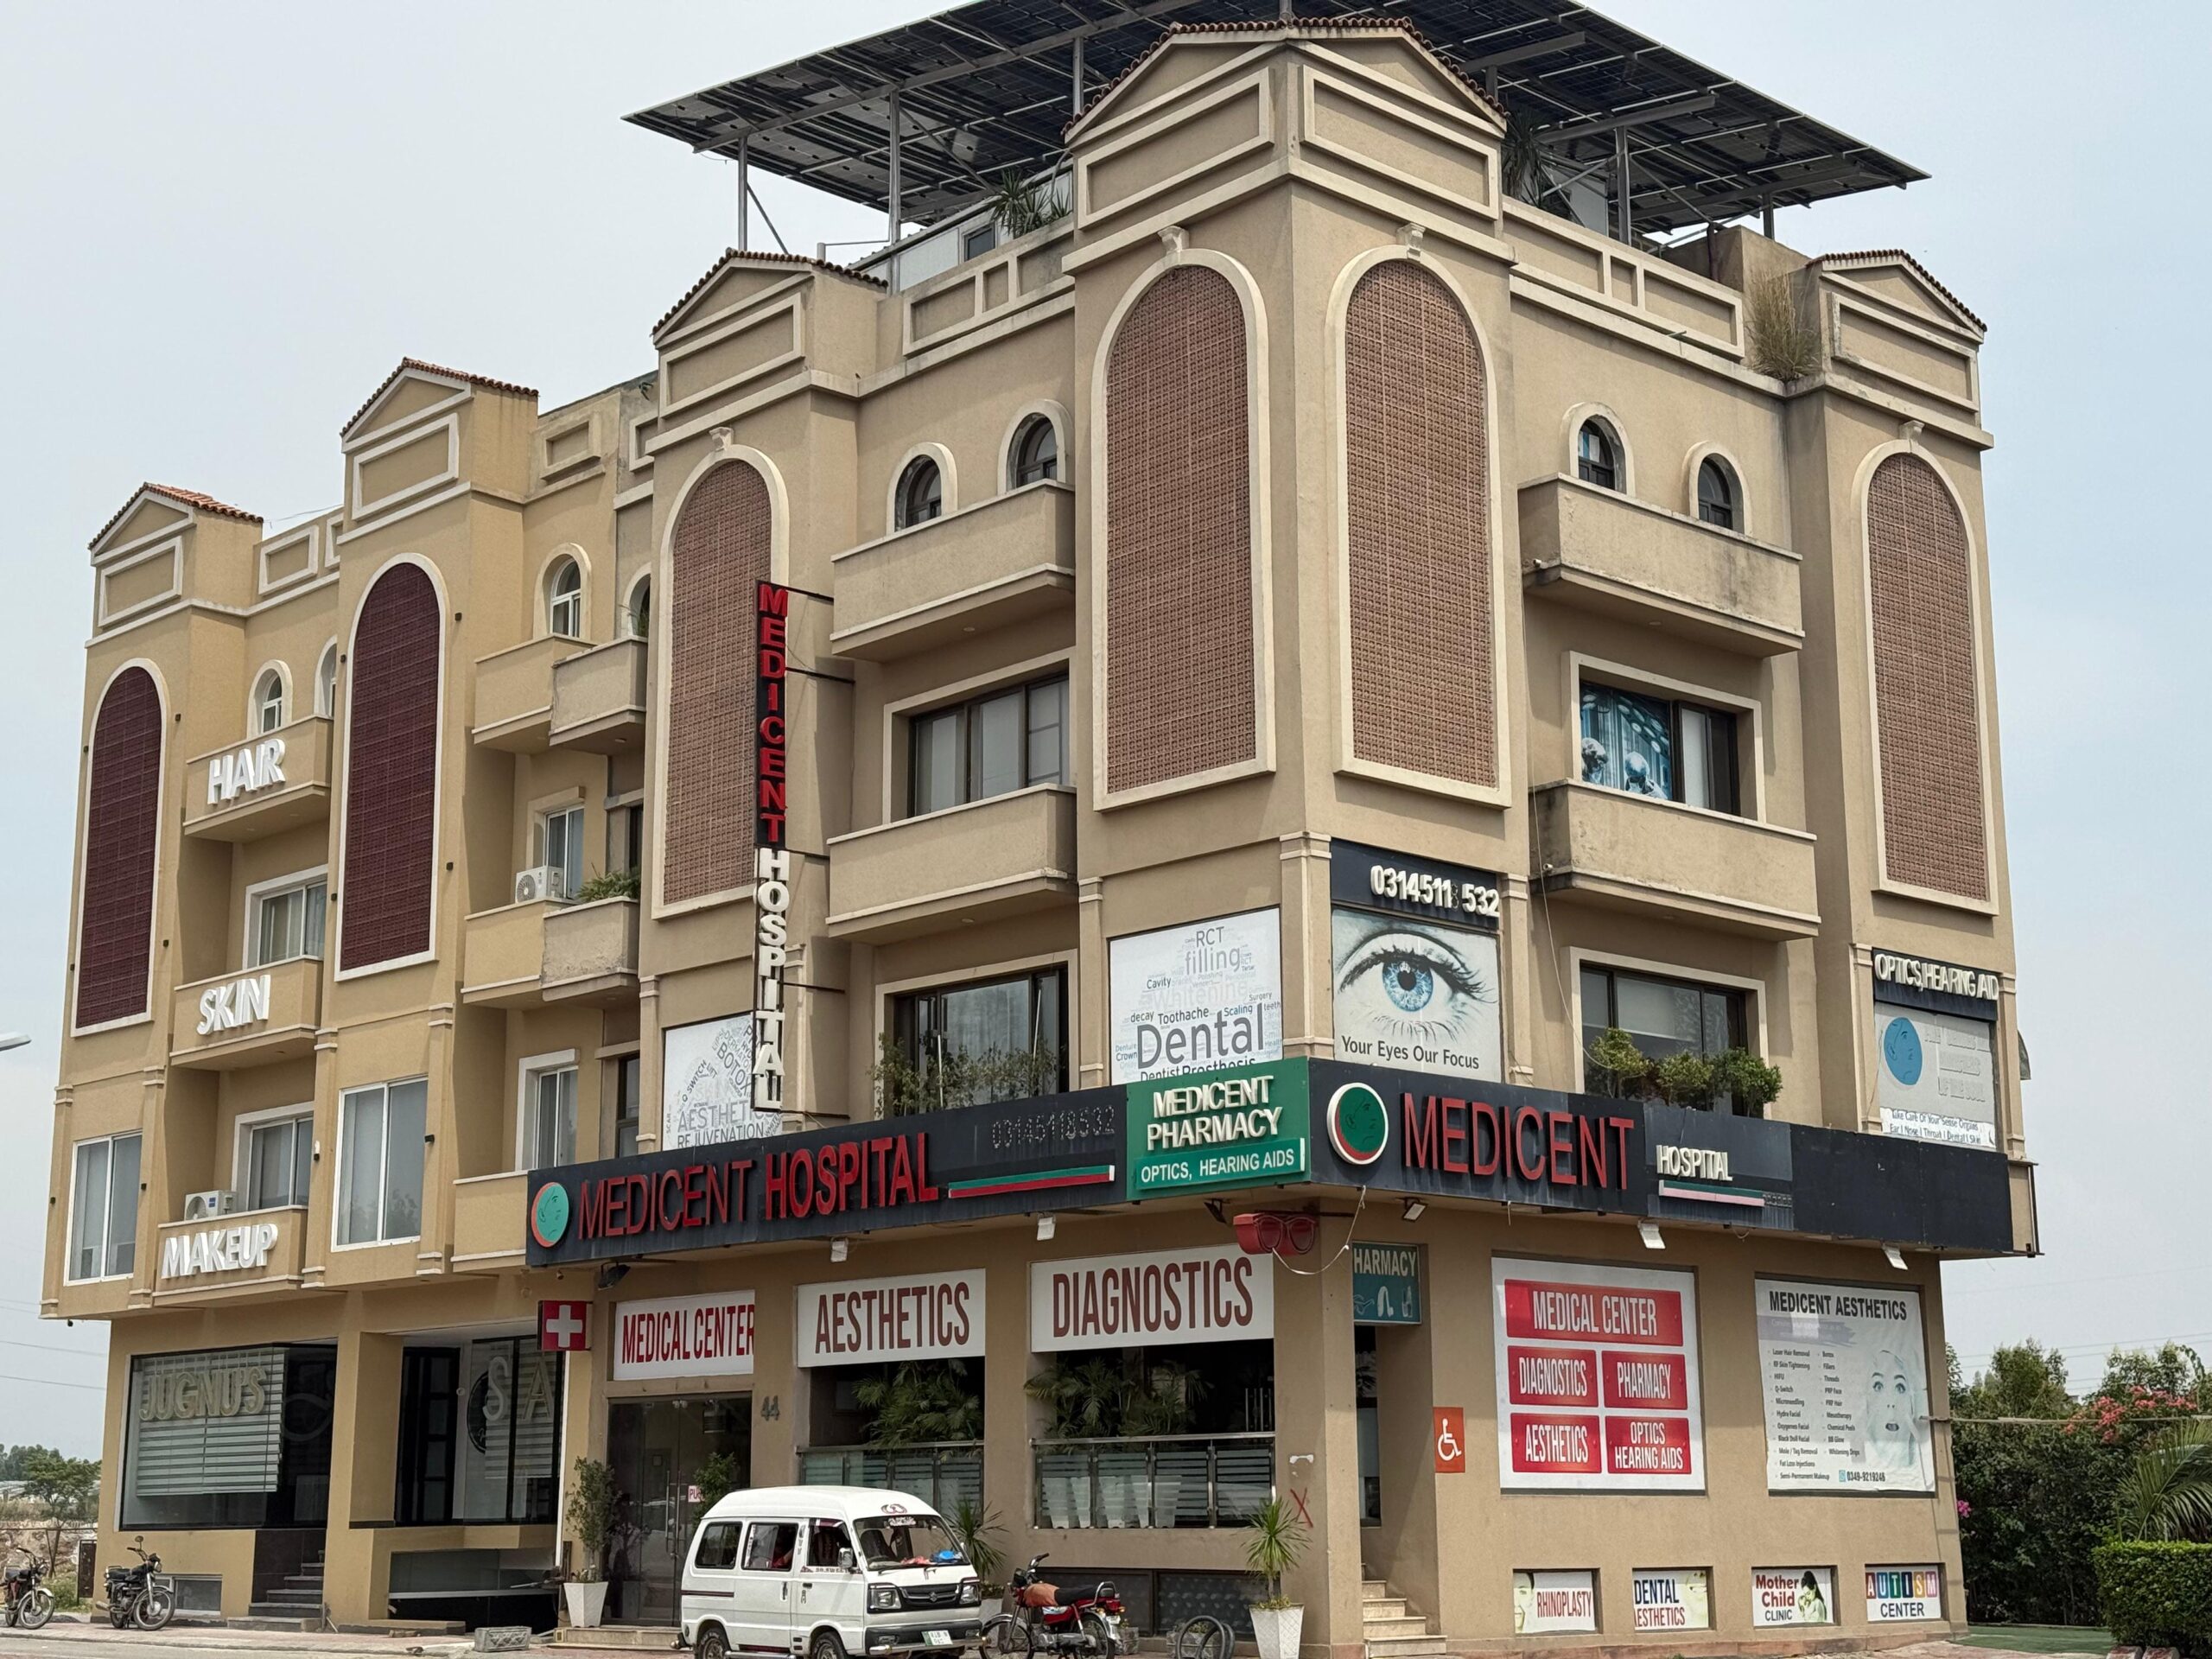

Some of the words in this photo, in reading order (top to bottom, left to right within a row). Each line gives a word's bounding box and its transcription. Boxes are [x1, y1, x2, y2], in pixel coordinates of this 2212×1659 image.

[759, 583, 788, 842] MEDICENT
[207, 738, 286, 804] HAIR
[1196, 926, 1224, 948] RCT
[1185, 947, 1240, 975] filling
[753, 847, 790, 1109] HOSPITAL
[1147, 976, 1172, 989] Cavity
[196, 975, 270, 1035] SKIN
[1224, 1004, 1253, 1017] Scaling
[1249, 992, 1272, 1001] Surgery
[1130, 1011, 1154, 1023] decay
[1158, 1007, 1209, 1025] Toothache
[1137, 1002, 1264, 1069] Dental
[1116, 1052, 1138, 1062] Crown
[1341, 1035, 1373, 1055] Your
[1377, 1040, 1408, 1061] Eyes
[1413, 1046, 1439, 1064] Our
[1443, 1049, 1479, 1070] Focus
[687, 1059, 707, 1094] SWITCH
[717, 1042, 752, 1097] BOTOX
[1154, 1076, 1274, 1118] MEDICENT
[1147, 1107, 1282, 1151] PHARMACY
[1890, 1123, 1899, 1133] Ear
[1905, 1111, 1918, 1121] Care
[1401, 1092, 1634, 1190] MEDICENT
[1141, 1162, 1192, 1183] OPTICS,
[1199, 1154, 1260, 1176] HEARING
[1263, 1148, 1294, 1168] AIDS
[1656, 1145, 1733, 1181] HOSPITAL
[579, 1160, 756, 1240] MEDICENT
[765, 1132, 939, 1220] HOSPITAL
[161, 1224, 278, 1279] MAKEUP
[1353, 1248, 1417, 1277] HARMACY
[1053, 1256, 1253, 1338] DIAGNOSTICS
[1770, 1291, 1832, 1315] MEDICENT
[1835, 1295, 1908, 1320] AESTHETICS
[816, 1281, 969, 1354] AESTHETICS
[1533, 1291, 1599, 1332] MEDICAL
[1602, 1295, 1657, 1336] CENTER
[621, 1310, 690, 1363] MEDICAL
[693, 1304, 754, 1359] CENTER
[1519, 1357, 1587, 1397] DIAGNOSTICS
[1617, 1362, 1671, 1400] PHARMACY
[760, 1395, 780, 1421] 44
[1525, 1425, 1588, 1463] AESTHETICS
[1630, 1422, 1666, 1445] OPTICS
[1615, 1446, 1659, 1469] HEARING
[1661, 1447, 1683, 1470] AIDS
[1634, 1579, 1680, 1605] DENTAL
[1756, 1574, 1799, 1590] Mother
[1866, 1573, 1937, 1598] AUTISM
[1536, 1591, 1592, 1618] RHINOPLASTY
[1761, 1591, 1796, 1608] Child
[1764, 1609, 1793, 1621] CLINIC
[1880, 1602, 1924, 1618] CENTER
